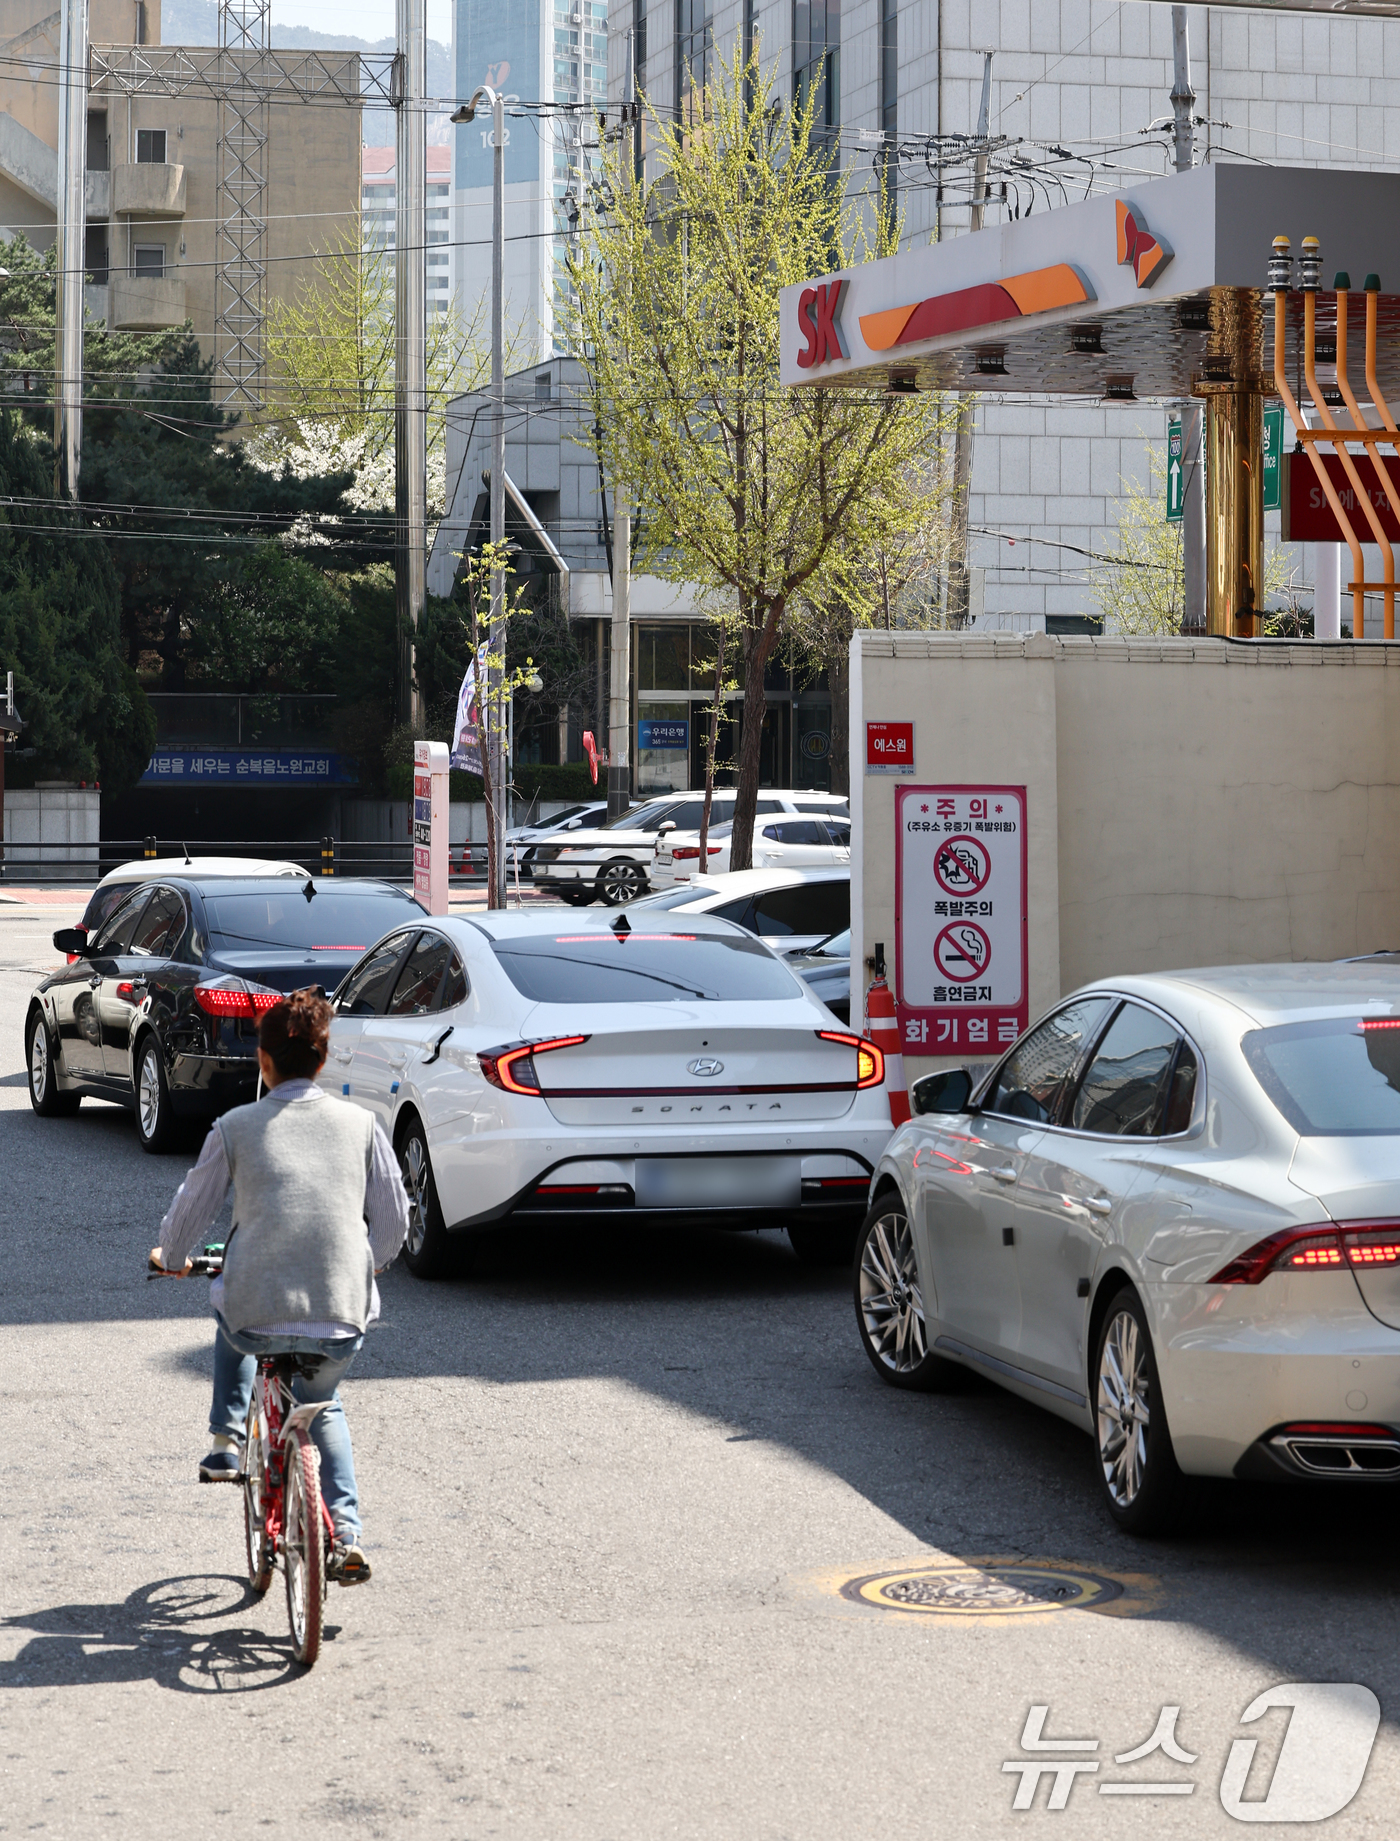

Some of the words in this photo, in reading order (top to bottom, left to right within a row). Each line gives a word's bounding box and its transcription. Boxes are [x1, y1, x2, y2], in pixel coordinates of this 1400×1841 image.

[796, 279, 848, 369] SK
[652, 727, 685, 737] 우리은행
[874, 738, 907, 753] 에스원
[144, 757, 185, 774] 가문을
[189, 757, 231, 774] 세우는
[235, 758, 330, 775] 순복음노원교회
[907, 821, 941, 833] (주유소
[943, 821, 972, 833] 유증기
[974, 821, 1017, 833] 폭발위험)
[934, 901, 993, 917] 폭발주의
[933, 986, 992, 1002] 흡연금지
[631, 1102, 782, 1113] SONATA
